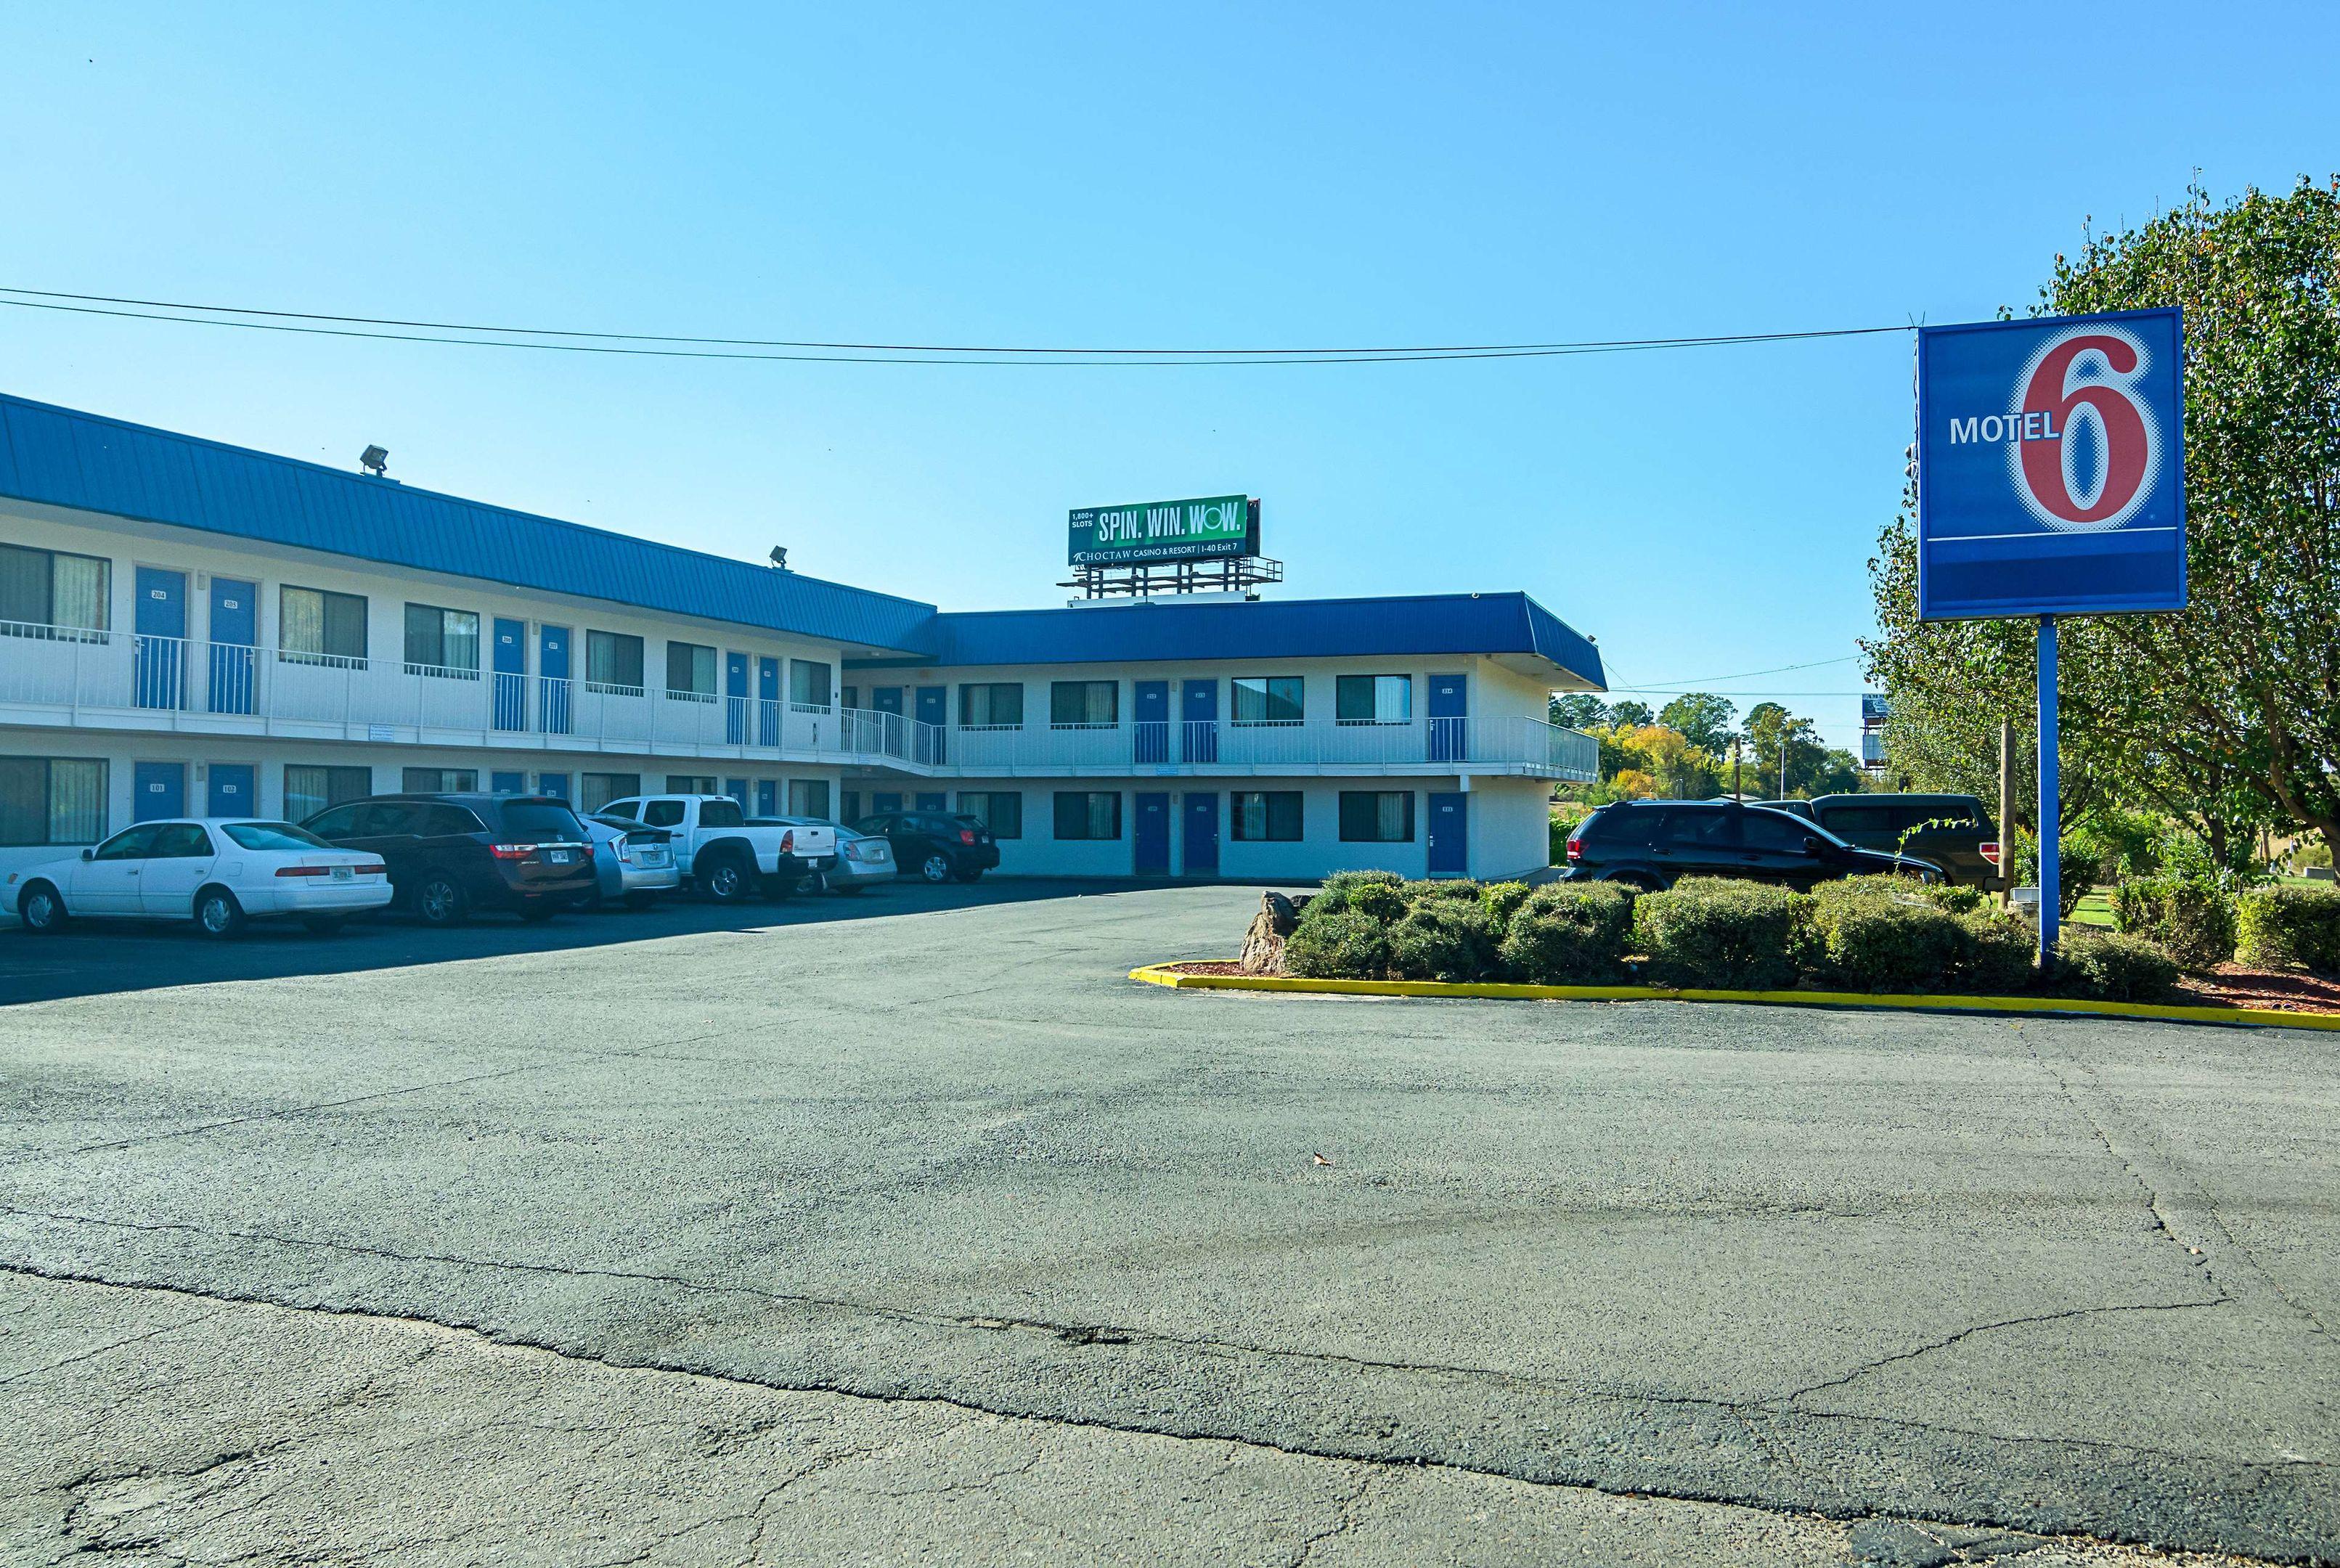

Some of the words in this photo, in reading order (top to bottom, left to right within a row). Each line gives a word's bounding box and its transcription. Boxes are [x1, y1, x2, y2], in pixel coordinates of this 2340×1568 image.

[1949, 411, 2060, 444] MOTEL
[2019, 335, 2149, 523] 6
[1072, 512, 1094, 520] 1,800+
[1072, 520, 1093, 528] SLOTS
[1098, 510, 1142, 542] SPIN.
[1146, 507, 1185, 537] WIN.
[1189, 501, 1241, 534] WOW.
[1078, 550, 1131, 562] CHOCTAW
[1133, 547, 1162, 558] CASINO
[1169, 545, 1197, 555] RESORT
[1201, 544, 1216, 552] I-40
[1217, 543, 1231, 552] Exit
